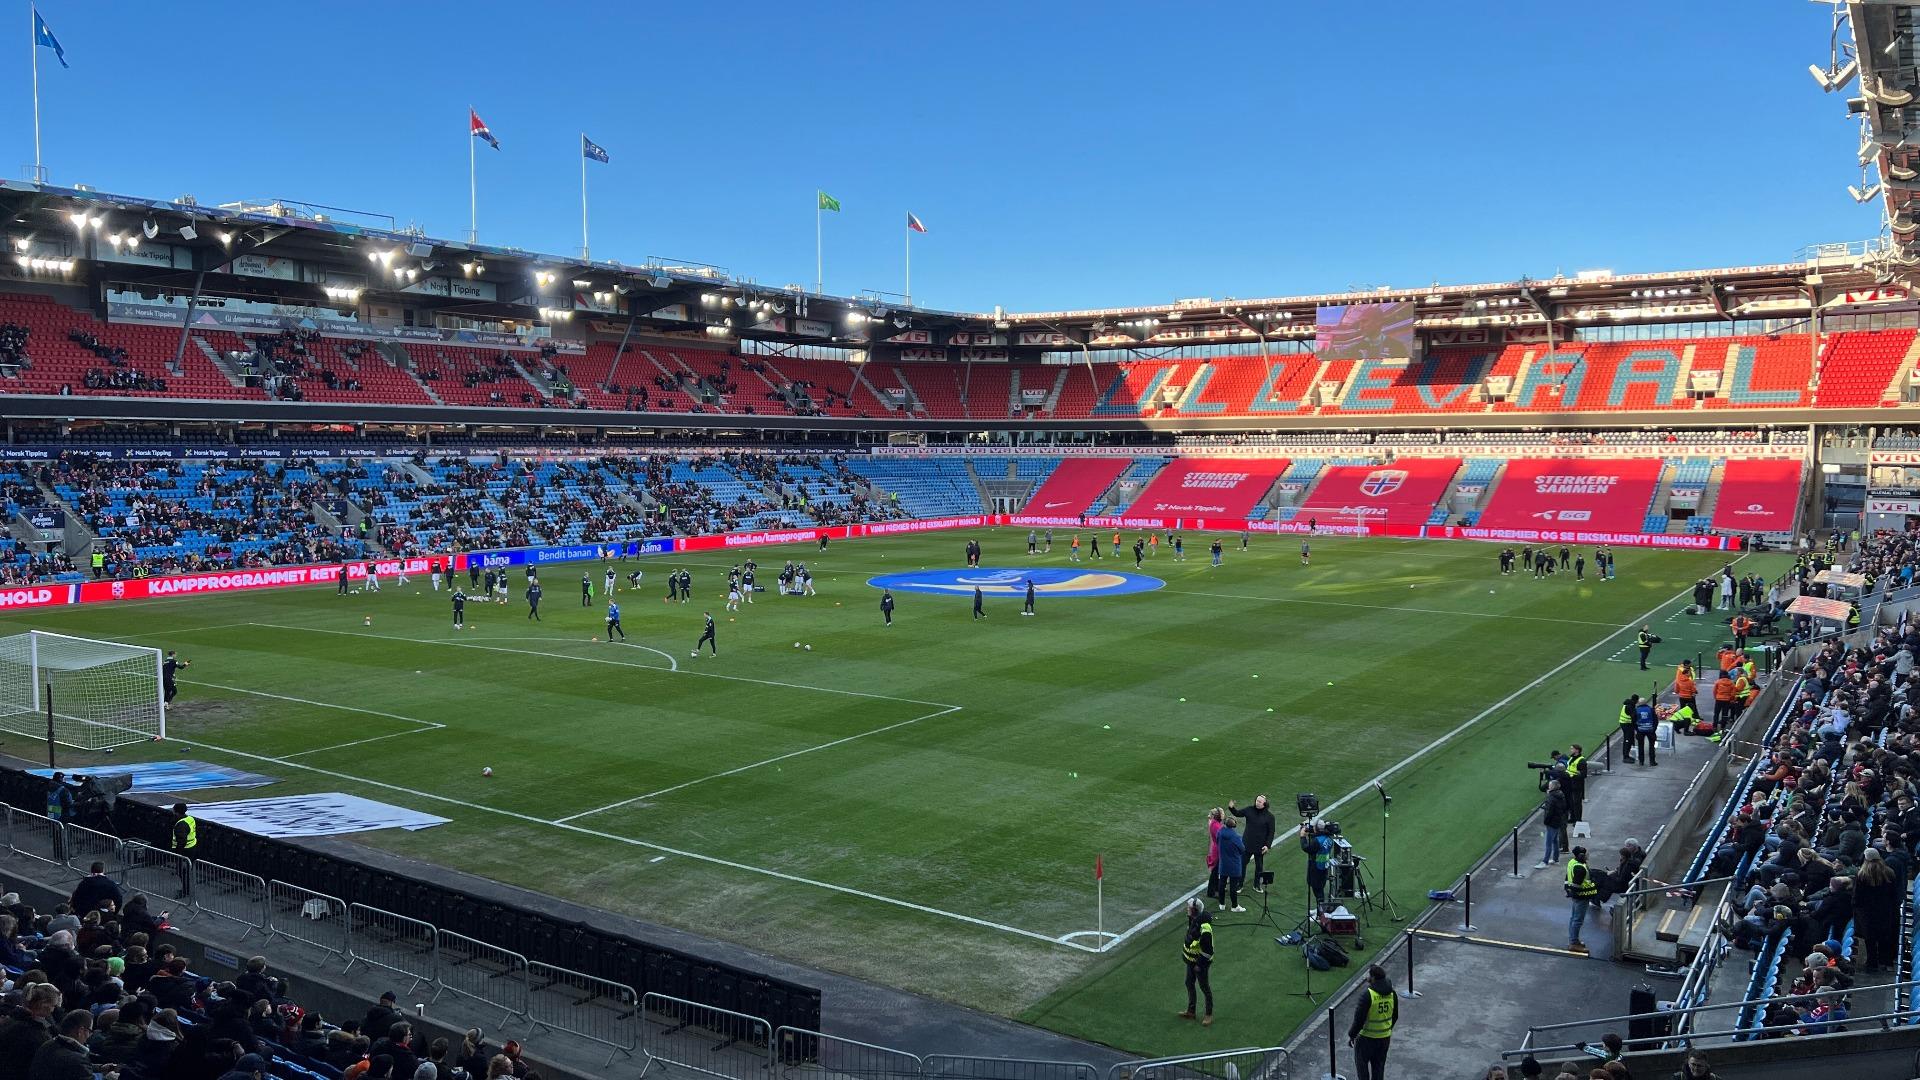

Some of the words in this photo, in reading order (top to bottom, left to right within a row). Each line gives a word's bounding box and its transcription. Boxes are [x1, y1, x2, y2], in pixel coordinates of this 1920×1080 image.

[431, 282, 449, 291] Nors
[453, 284, 480, 296] Tipping
[1846, 288, 1908, 303] VG
[154, 310, 176, 319] Tipping
[1184, 472, 1249, 480] STERKERE
[1535, 476, 1619, 484] STERKERE
[1536, 485, 1608, 493] SAMMEN
[1873, 503, 1908, 512] VG
[1010, 516, 1087, 524] KAMPPROGRAMM
[1112, 516, 1122, 526] PÅ
[1124, 518, 1163, 526] MOBILEN
[1462, 528, 1488, 537] VINN
[1490, 529, 1538, 539] PREMIER
[1541, 531, 1558, 539] OG
[1560, 532, 1574, 540] SE
[1577, 532, 1650, 544] EKSKLUSIVT
[1652, 535, 1708, 545] INNHOLD
[484, 554, 510, 565] bama
[539, 550, 567, 561] Bendit
[568, 548, 591, 559] banan
[150, 570, 306, 593] KAMPPROGRAMMET
[0, 590, 52, 606] HOLD
[1378, 1001, 1389, 1014] 55
